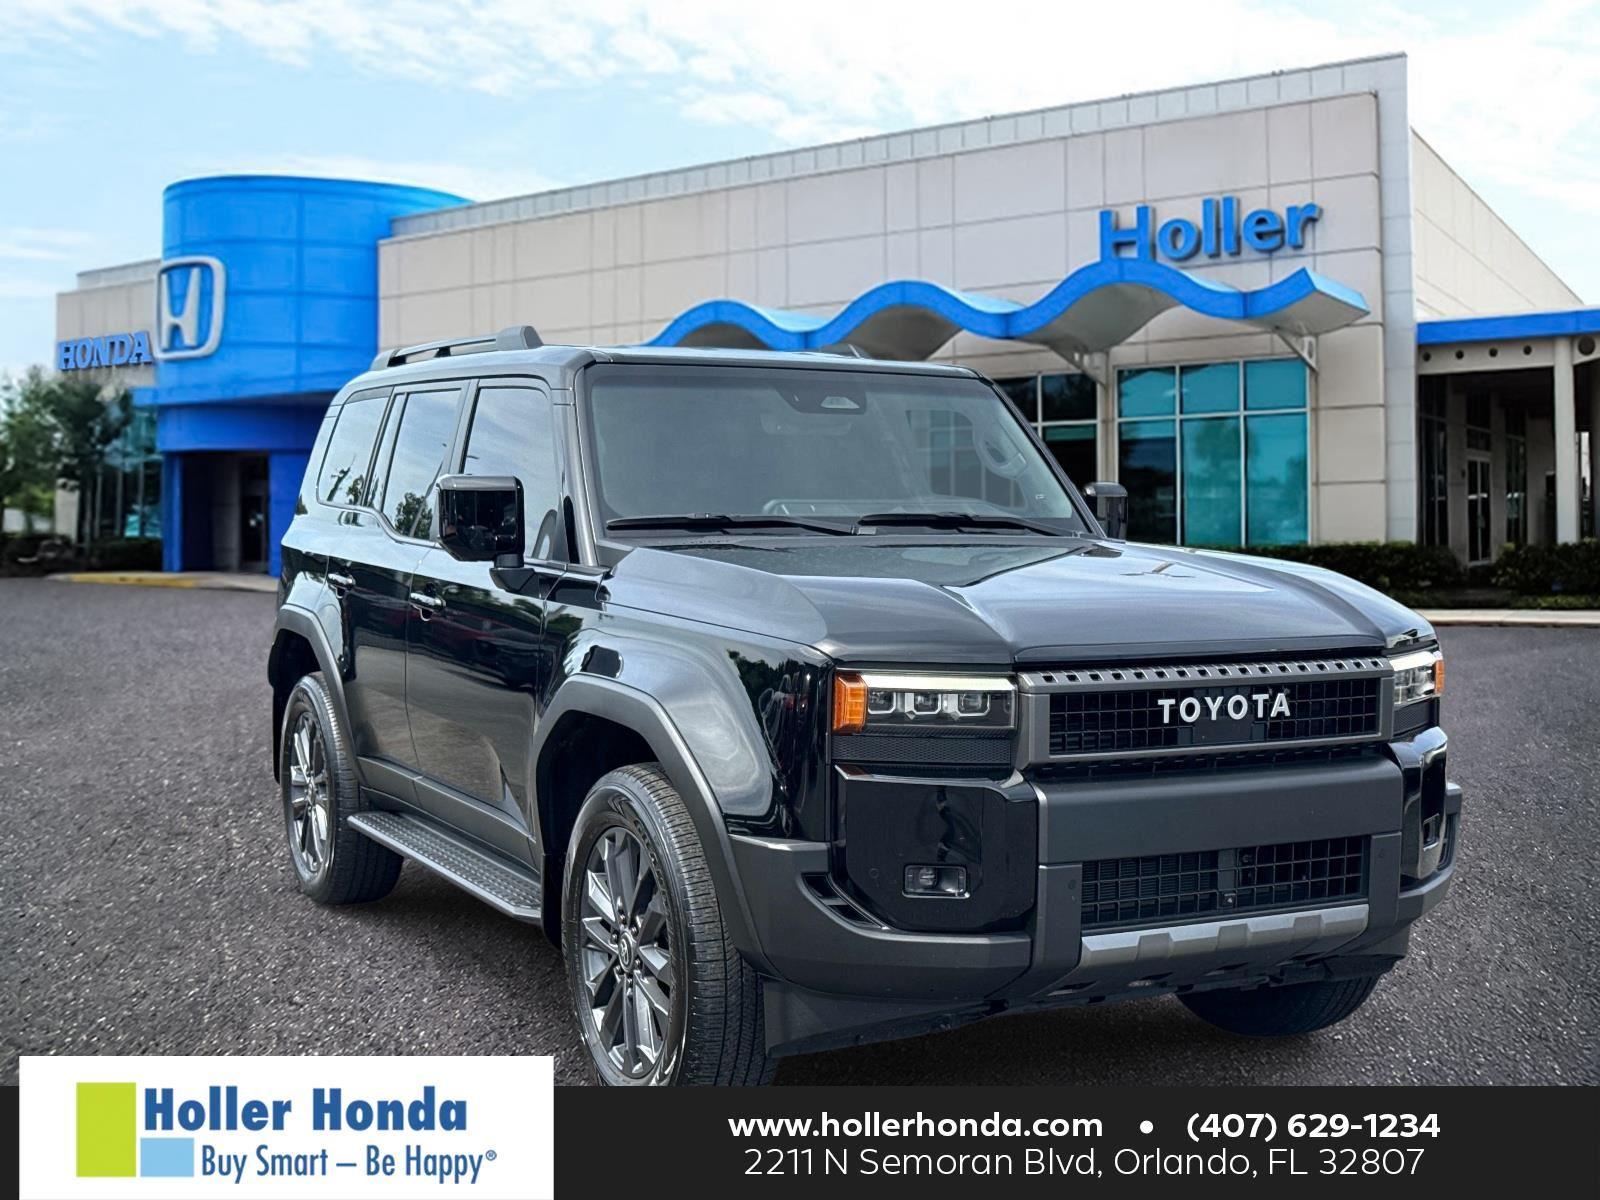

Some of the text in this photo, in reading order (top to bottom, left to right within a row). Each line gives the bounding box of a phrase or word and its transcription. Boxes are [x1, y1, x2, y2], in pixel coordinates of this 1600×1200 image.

[1099, 195, 1322, 263] Holler
[57, 330, 152, 371] HONDA
[1157, 692, 1291, 724] TOYOTA
